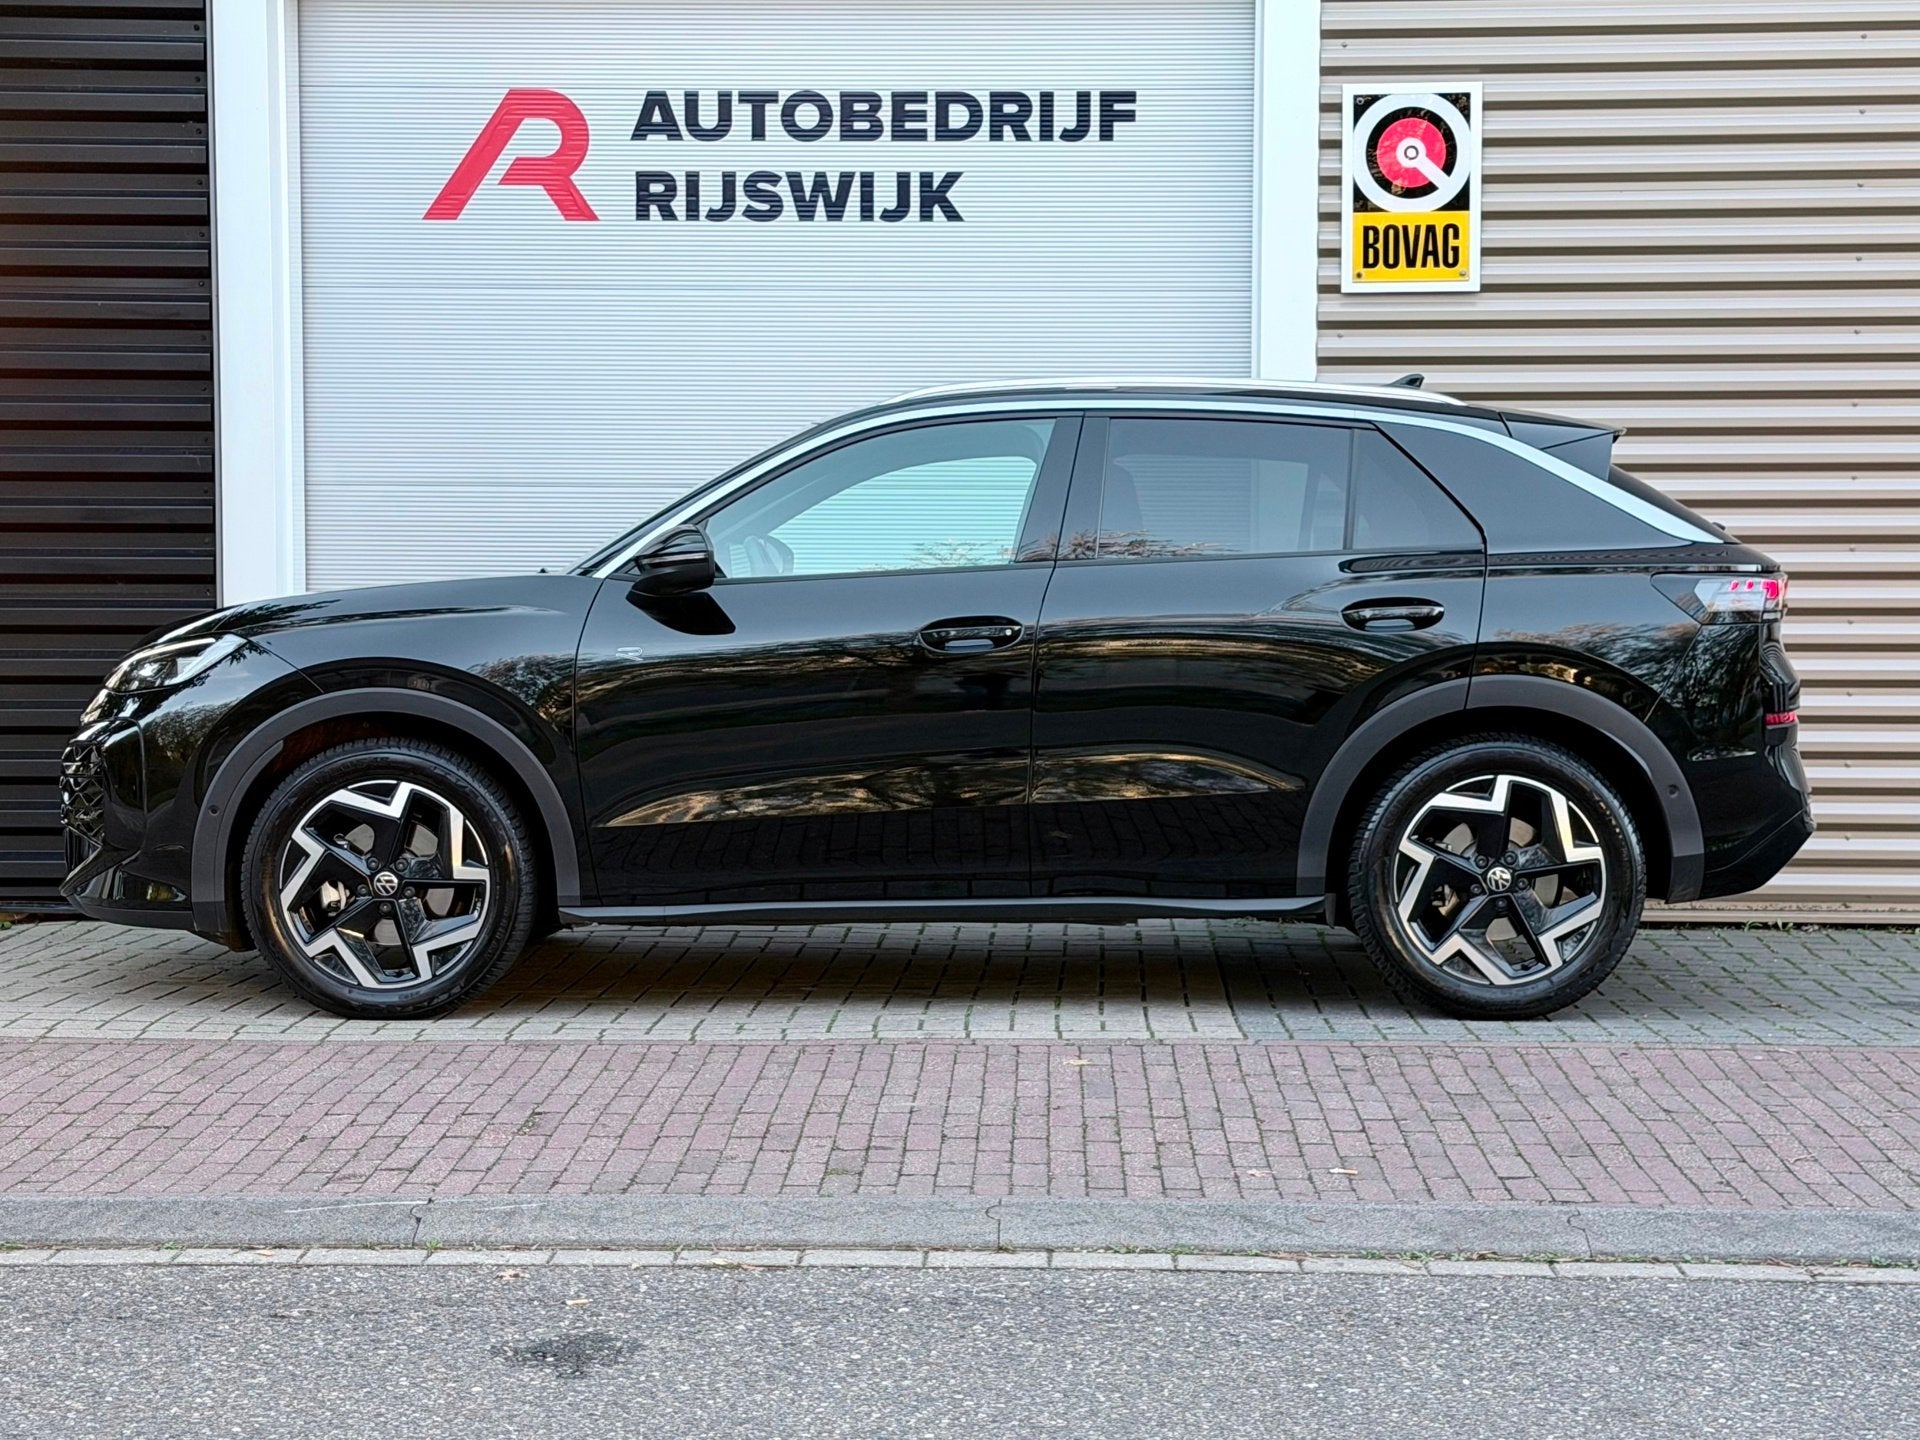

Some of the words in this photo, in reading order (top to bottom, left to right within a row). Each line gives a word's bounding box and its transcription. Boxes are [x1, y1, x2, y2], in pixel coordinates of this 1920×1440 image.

[630, 90, 1137, 143] AUTOBEDRIJF
[635, 170, 965, 223] RIJSWIJK
[1362, 223, 1460, 270] BOVAG
